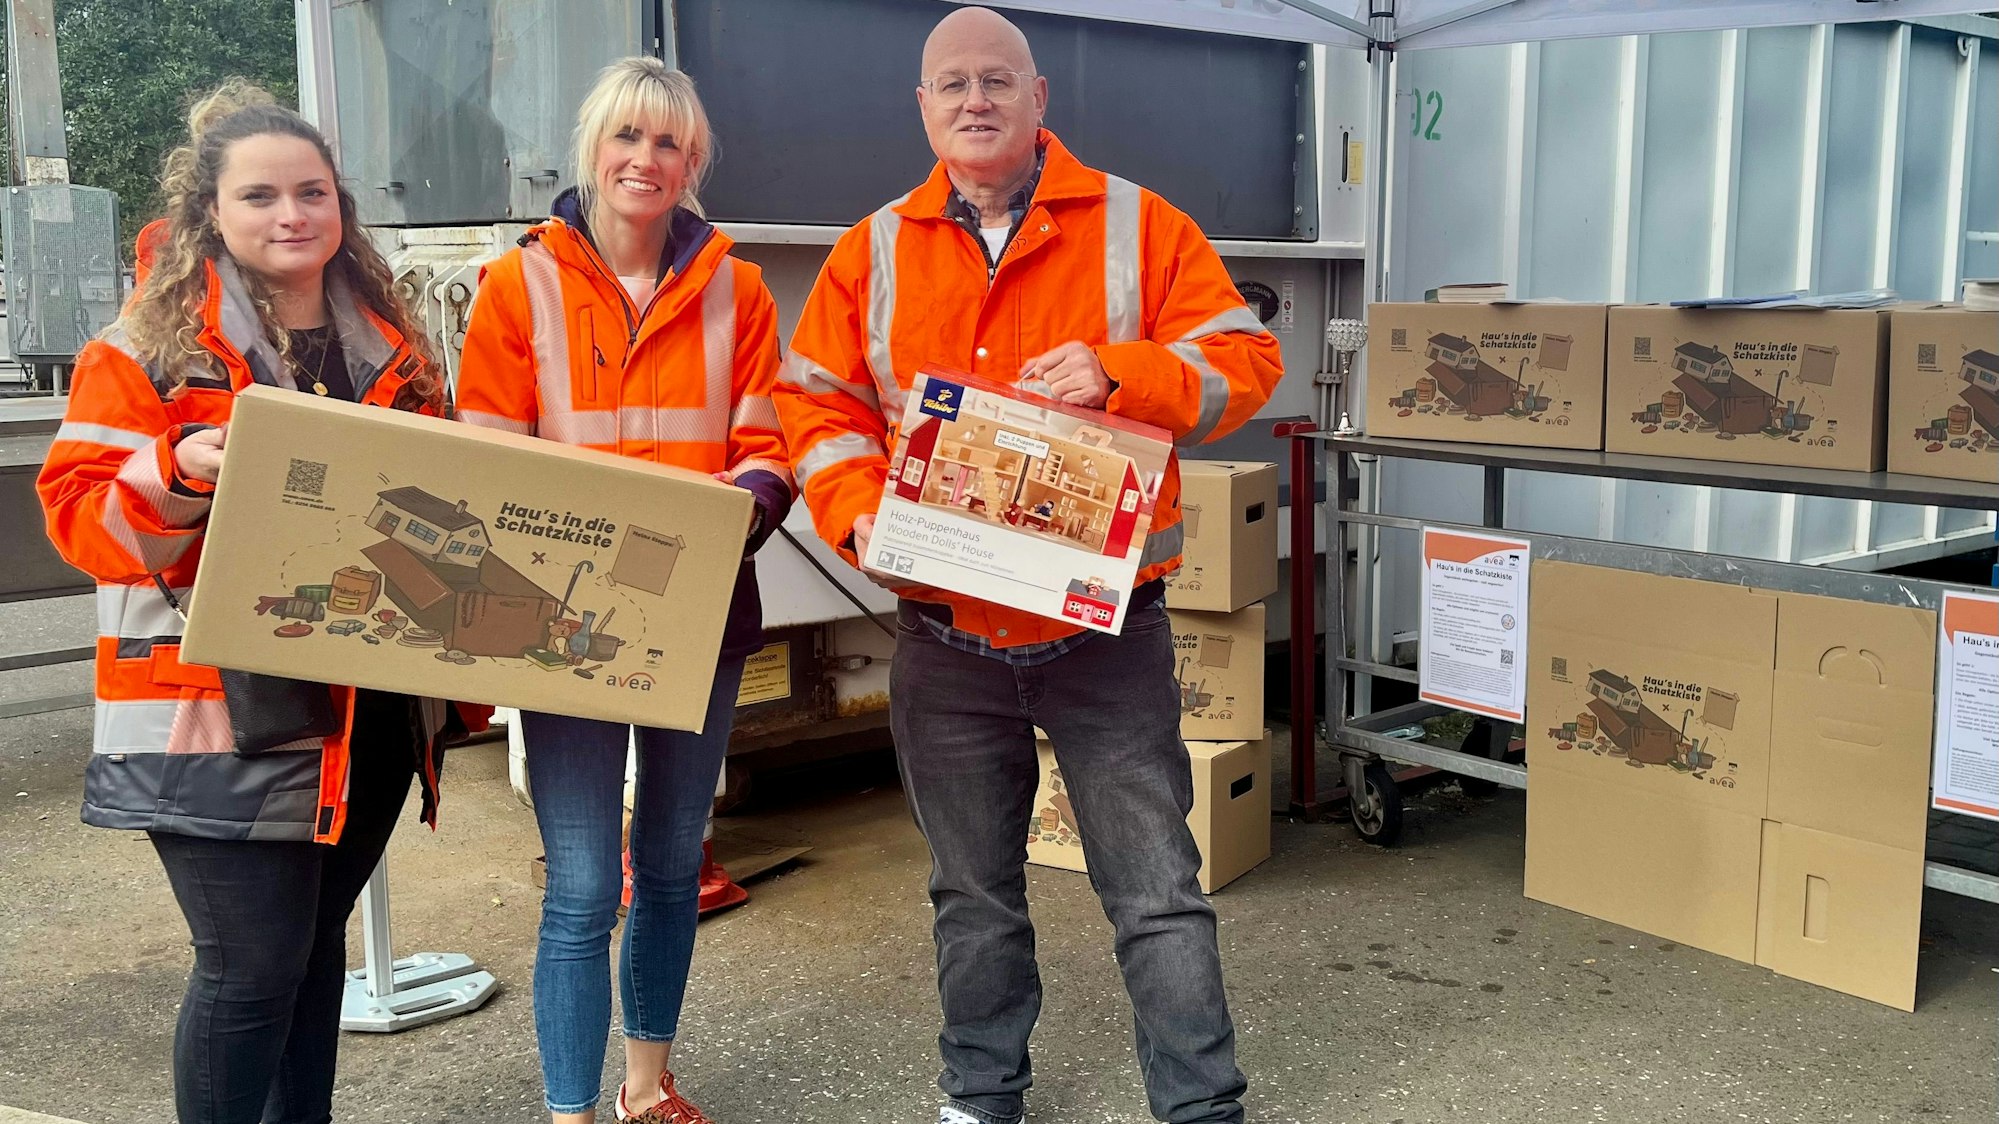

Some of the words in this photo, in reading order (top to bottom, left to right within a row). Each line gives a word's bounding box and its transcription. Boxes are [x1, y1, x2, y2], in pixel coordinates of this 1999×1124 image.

[1481, 332, 1509, 341] Hau's
[1510, 332, 1520, 340] in
[1522, 333, 1537, 341] die
[1480, 341, 1537, 349] Schatzkiste
[1734, 342, 1766, 351] Hau's
[1768, 342, 1779, 351] in
[1781, 343, 1797, 352] die
[1732, 351, 1797, 361] Schatzkiste
[1545, 415, 1571, 426] avea
[1807, 436, 1836, 447] avea
[500, 502, 559, 524] Hau's
[562, 512, 582, 528] in
[585, 518, 616, 534] die
[890, 510, 981, 542] Holz-Puppenhaus
[494, 516, 612, 548] Schatzkiste
[887, 523, 928, 543] Wooden
[962, 543, 995, 560] House
[1484, 555, 1505, 566] avea
[1436, 562, 1454, 571] Hau's
[1463, 566, 1473, 575] die
[1475, 569, 1512, 580] Schatzkiste
[1178, 580, 1203, 591] avea
[1182, 633, 1198, 641] die
[1963, 636, 1990, 648] Hau's
[606, 672, 656, 691] avea
[1643, 675, 1673, 688] Hau's
[1675, 680, 1684, 690] in
[1686, 681, 1702, 693] die
[1642, 684, 1701, 702] Schatzkiste
[1208, 709, 1233, 720] avea
[1709, 776, 1736, 789] avea
